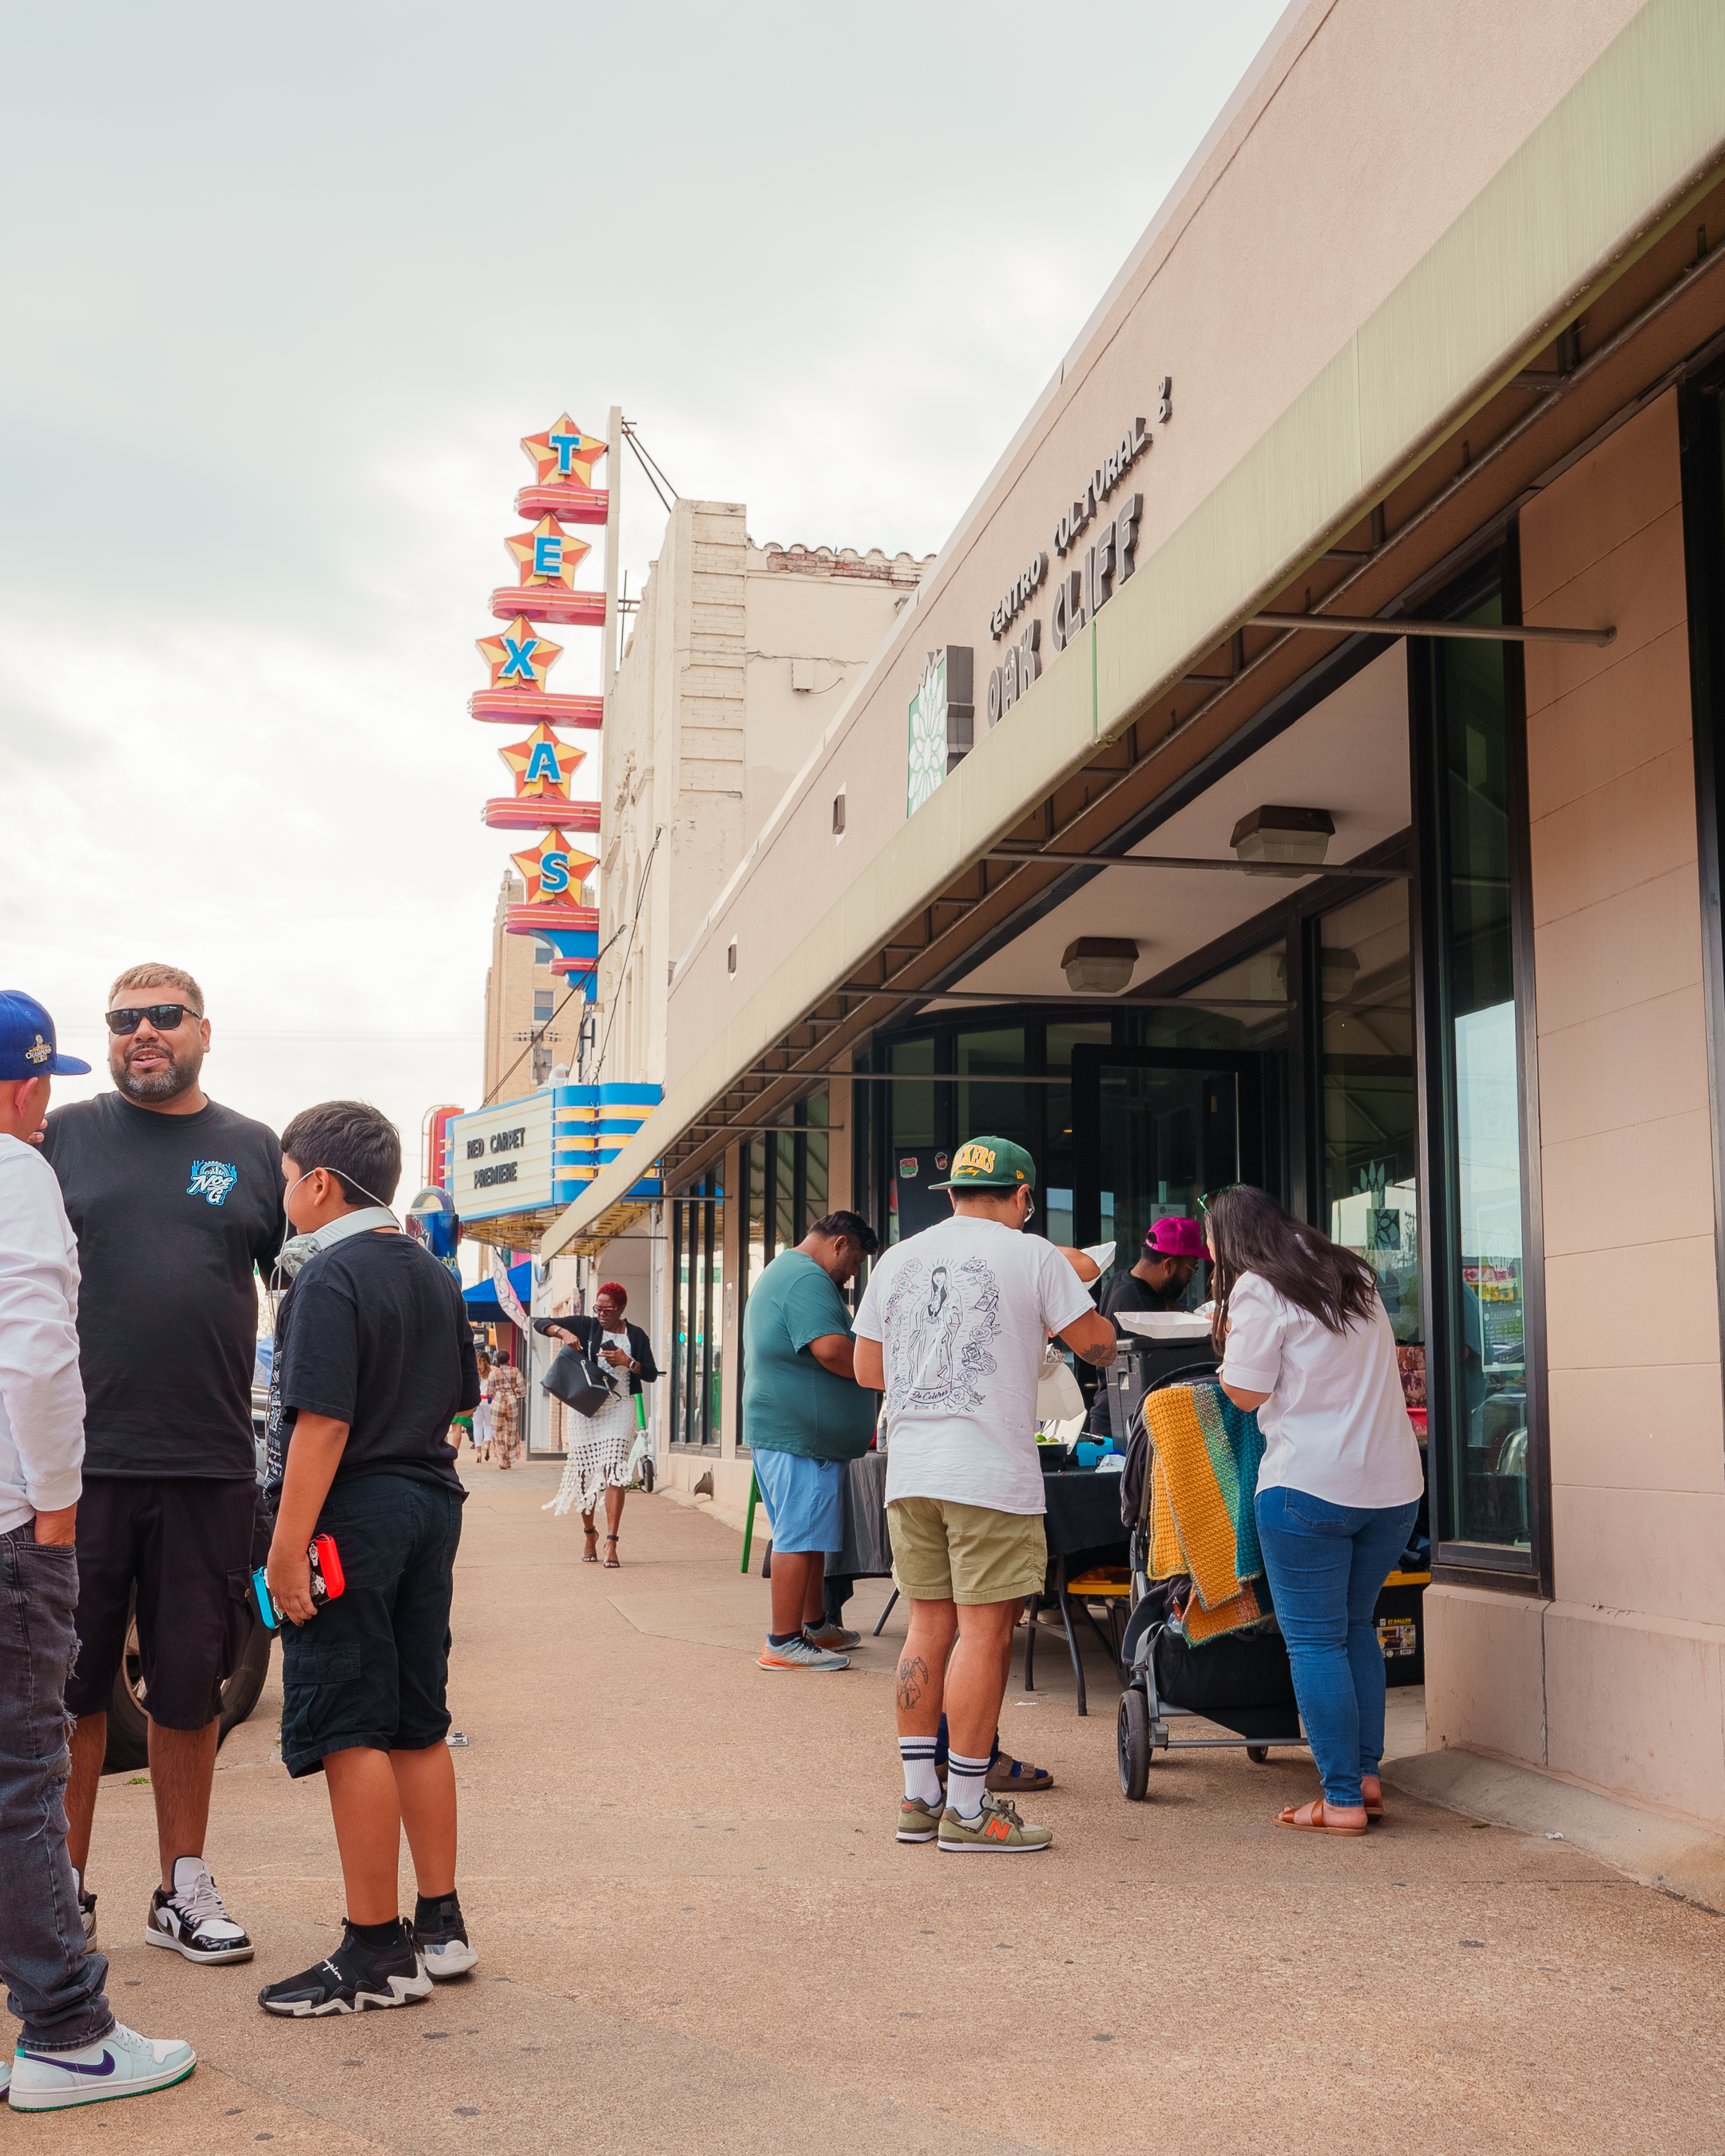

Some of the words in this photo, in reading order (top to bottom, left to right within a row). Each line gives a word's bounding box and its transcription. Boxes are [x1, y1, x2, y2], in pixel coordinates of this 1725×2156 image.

[990, 552, 1048, 640] CENTRO
[1053, 418, 1152, 556] CULTURAL
[987, 620, 1041, 729] OAK
[1052, 493, 1143, 652] CLIFF
[498, 433, 581, 894] TEXAS
[467, 1138, 484, 1159] RED
[490, 1127, 525, 1154] CARPET
[188, 1175, 234, 1192] Noe
[474, 1161, 518, 1189] PREMIERE
[208, 1189, 223, 1203] G
[1489, 1310, 1516, 1321] CALENDAR
[985, 1818, 1011, 1841] N
[323, 1959, 343, 1980] mpion
